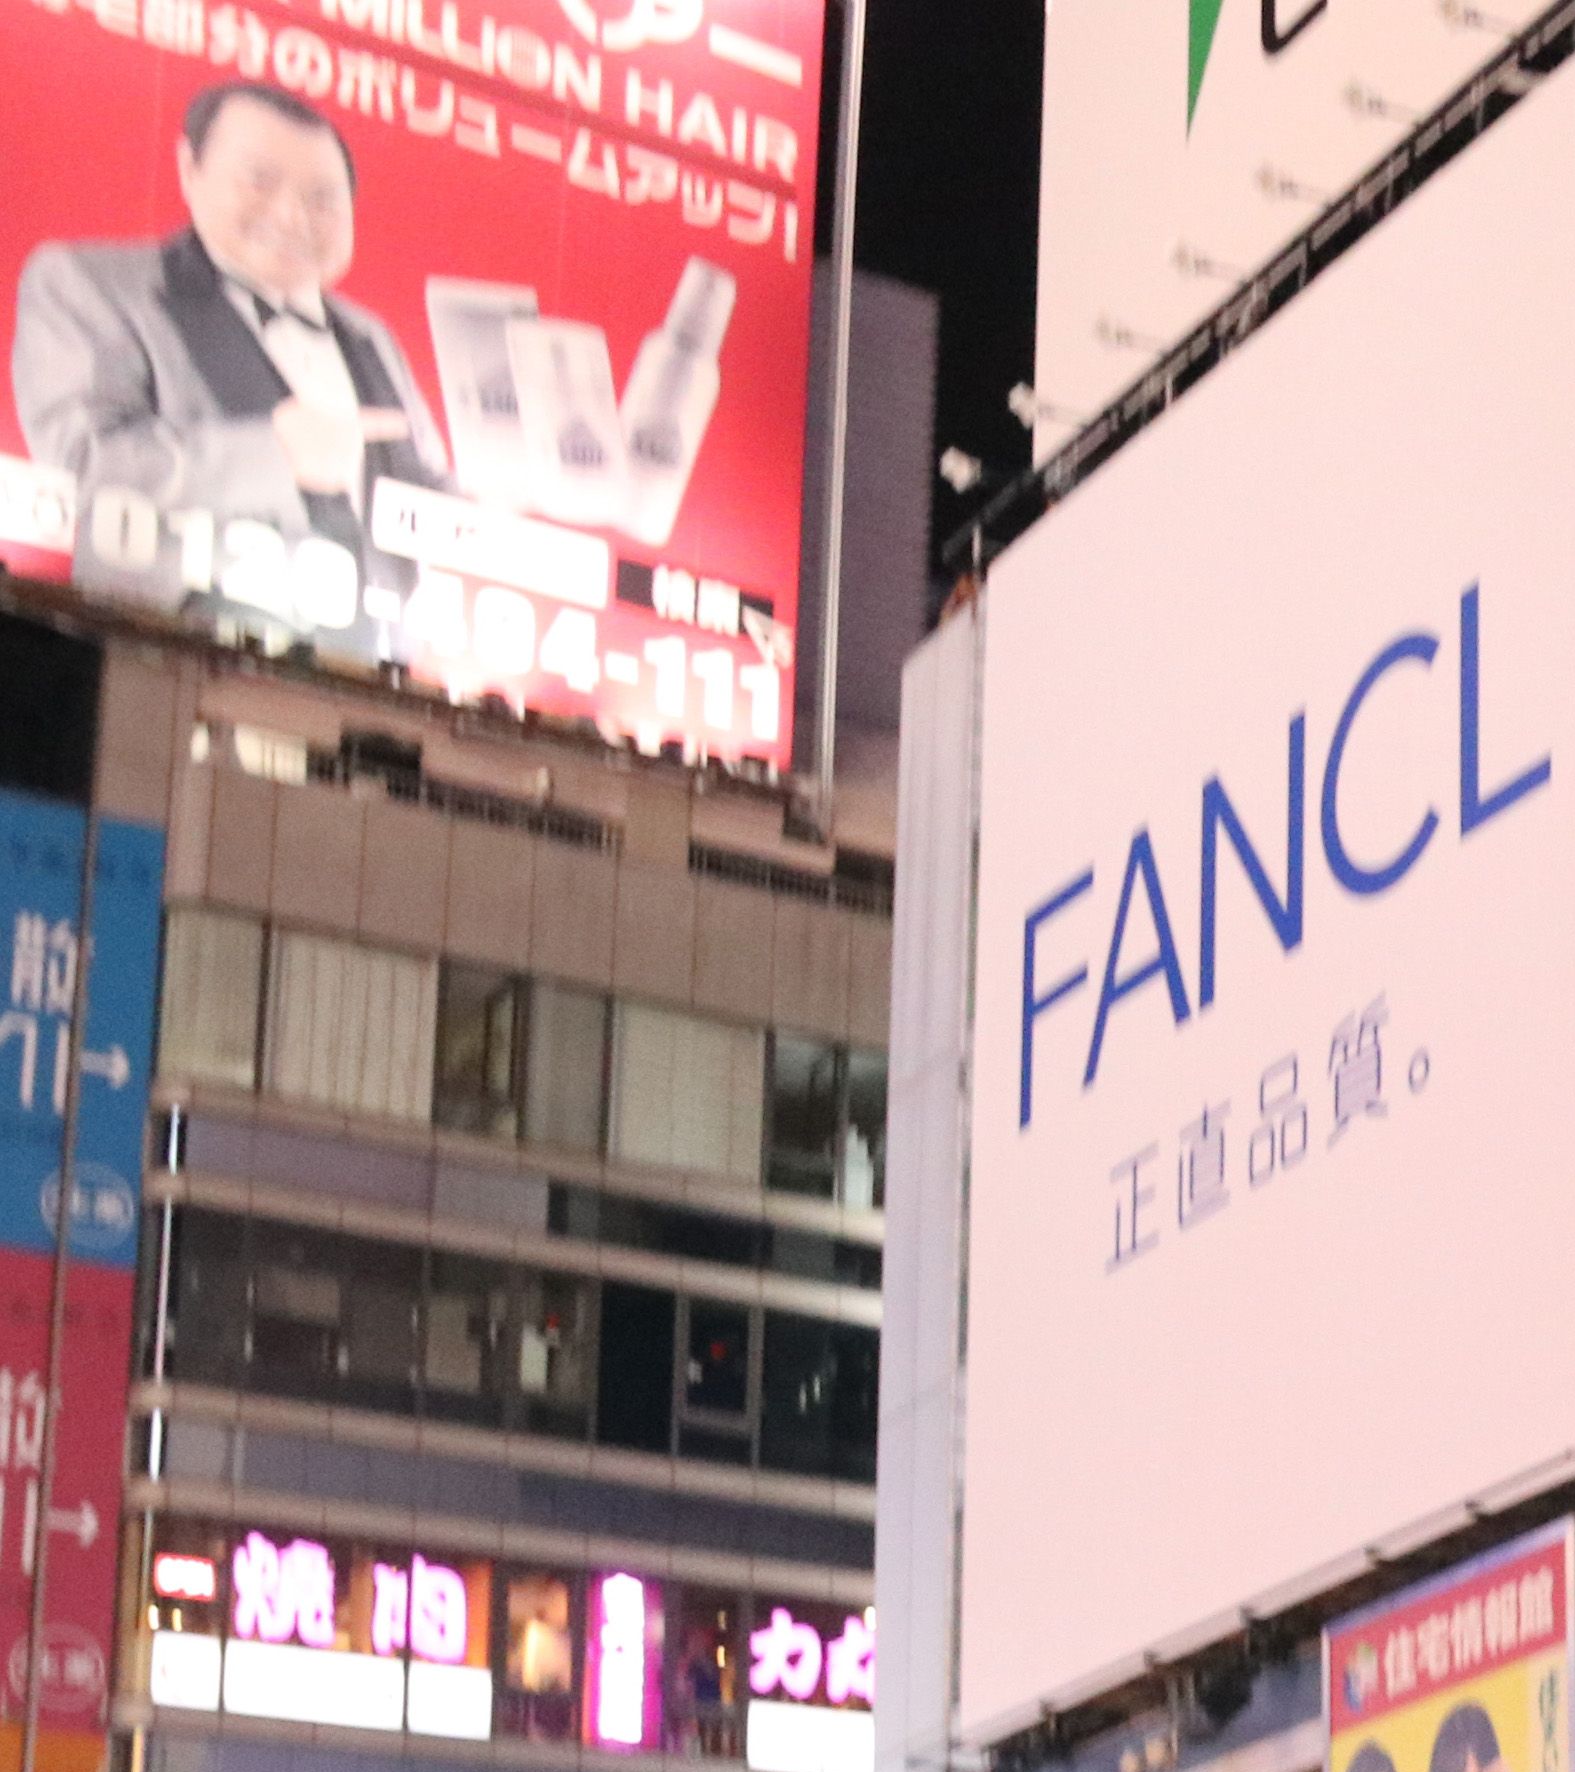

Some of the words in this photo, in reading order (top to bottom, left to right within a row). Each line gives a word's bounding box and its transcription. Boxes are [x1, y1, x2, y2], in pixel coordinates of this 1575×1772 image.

[624, 66, 799, 183] HAIR
[1019, 577, 1552, 1131] FANCL
[1105, 992, 1431, 1275] 正直品質。
